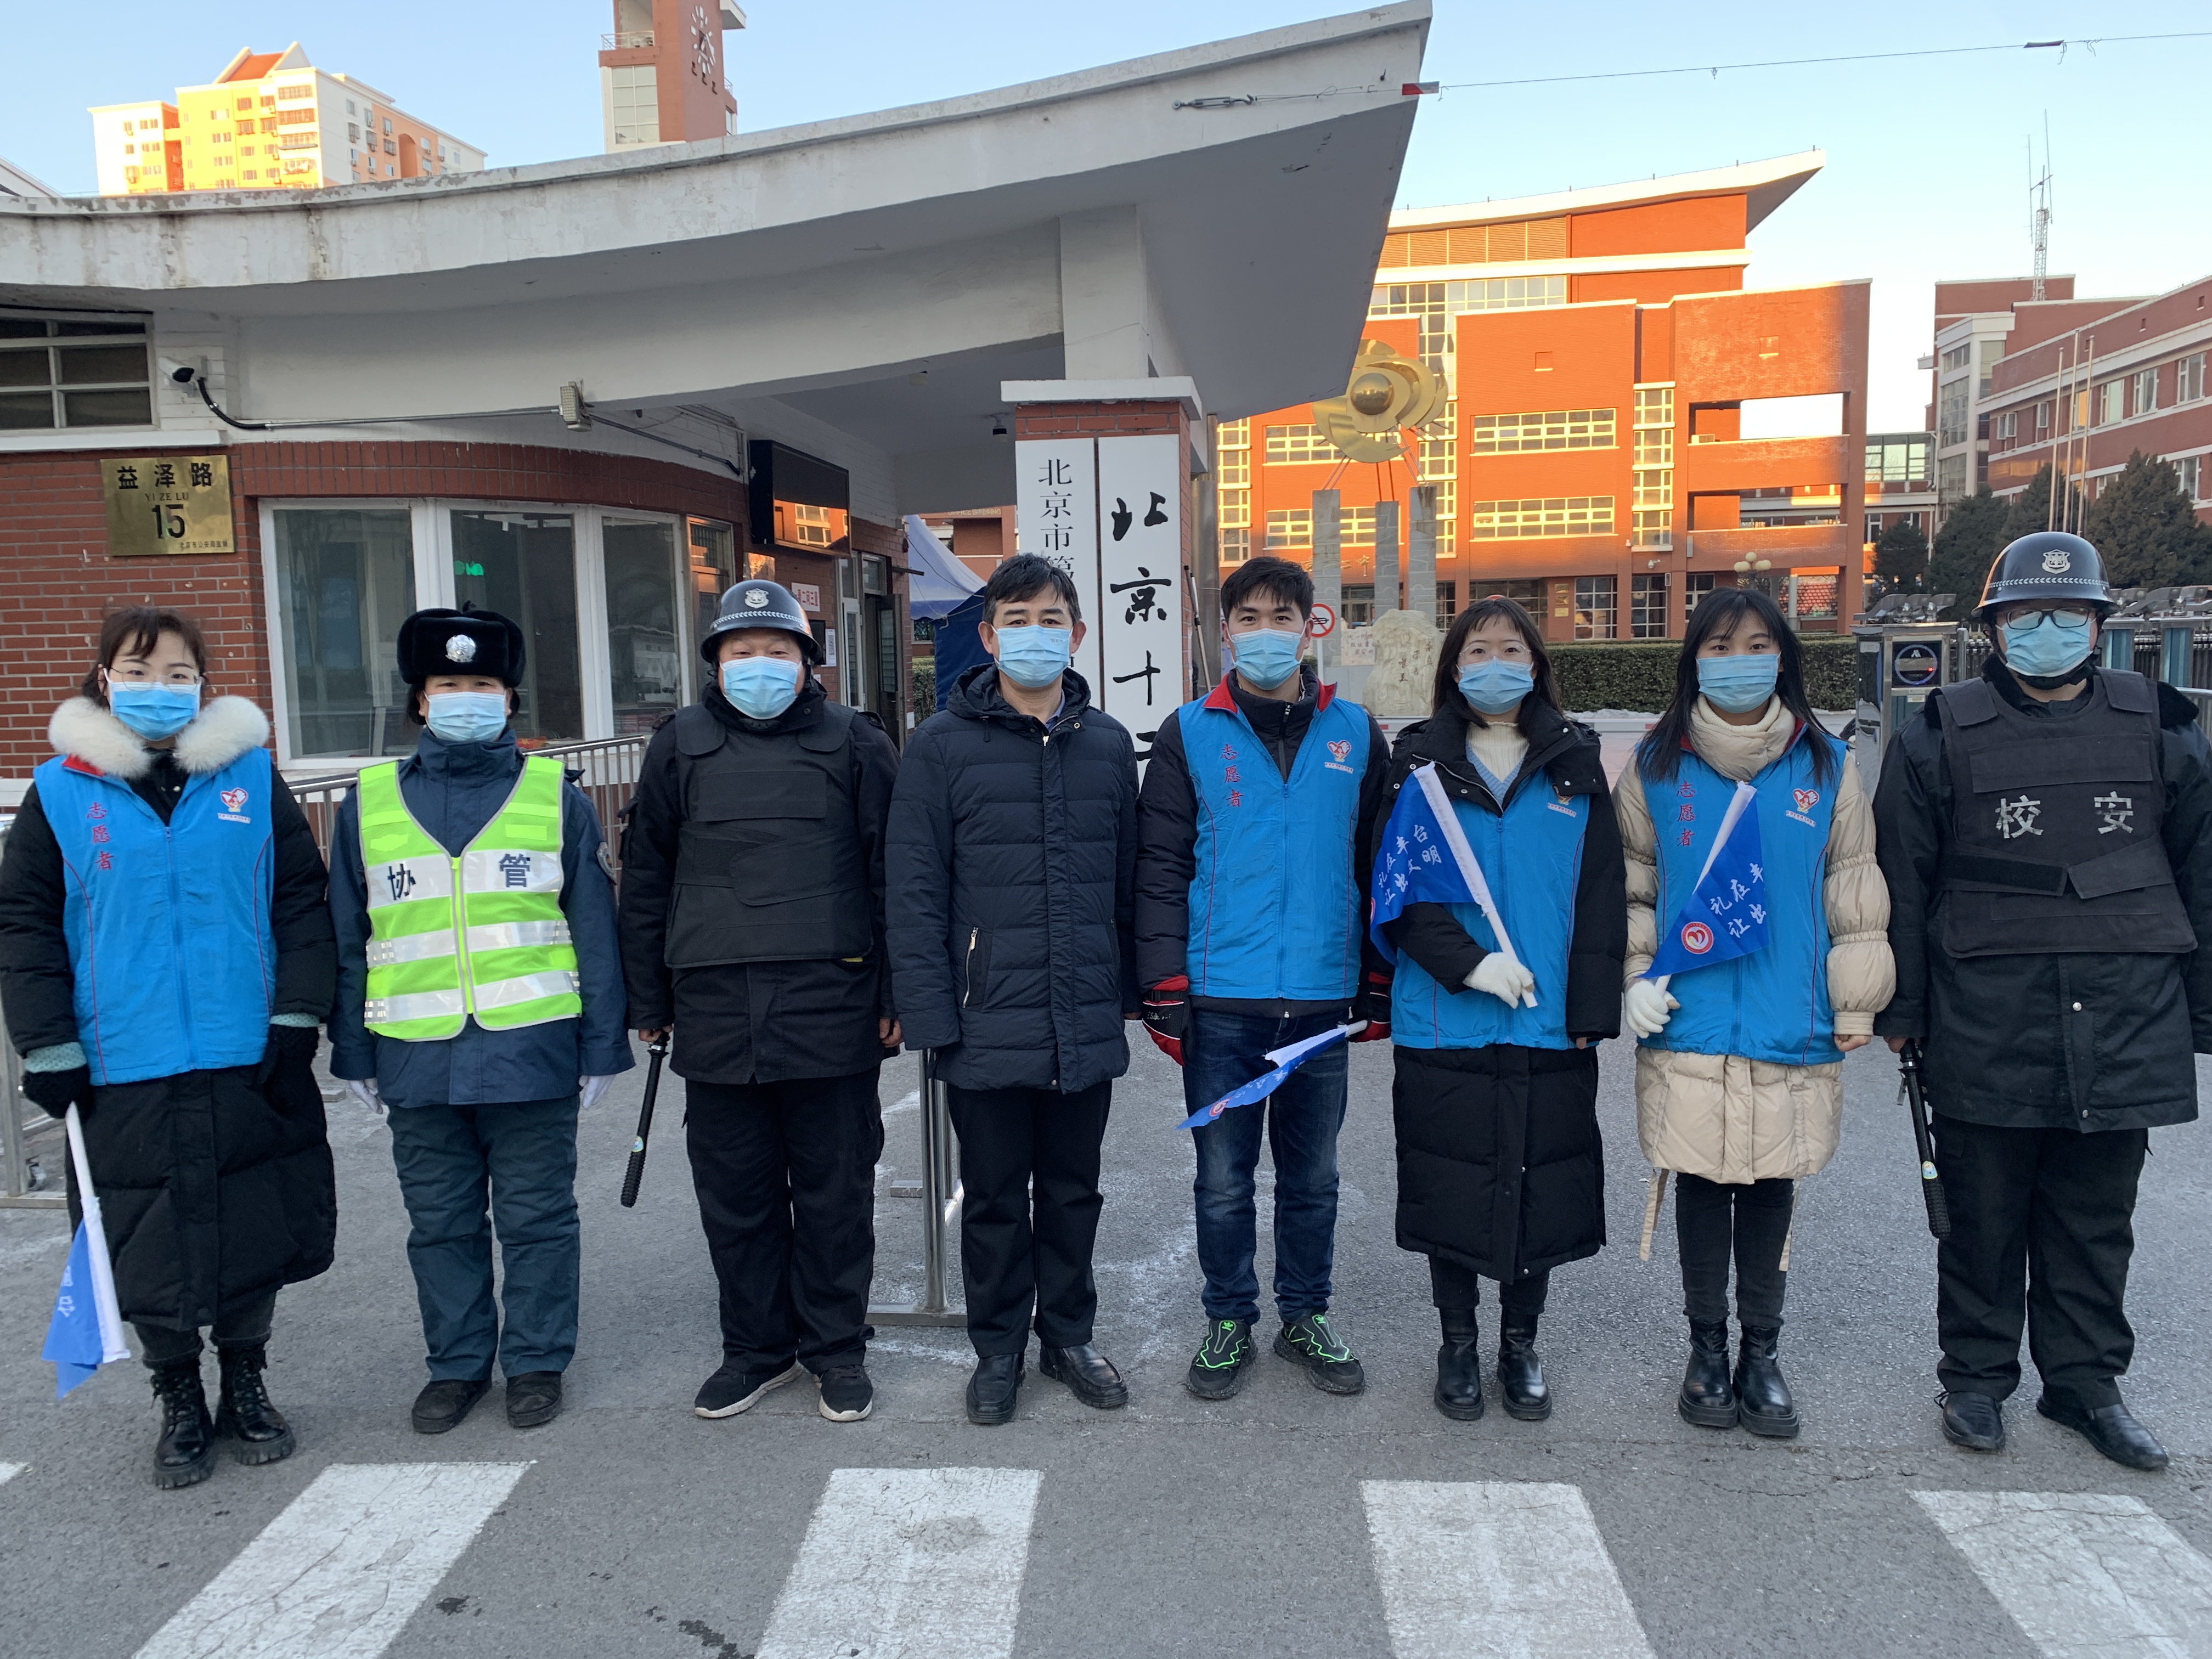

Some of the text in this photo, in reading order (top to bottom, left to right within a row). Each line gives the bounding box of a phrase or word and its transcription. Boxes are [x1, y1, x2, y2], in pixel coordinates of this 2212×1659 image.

[116, 462, 213, 489] 益泽路
[145, 493, 155, 501] YI
[176, 492, 189, 500] LU
[151, 504, 185, 539] 15
[1221, 743, 1244, 808] 志愿者
[86, 802, 114, 871] 志愿者
[1676, 781, 1696, 847] 志愿者
[387, 853, 531, 901] 协管
